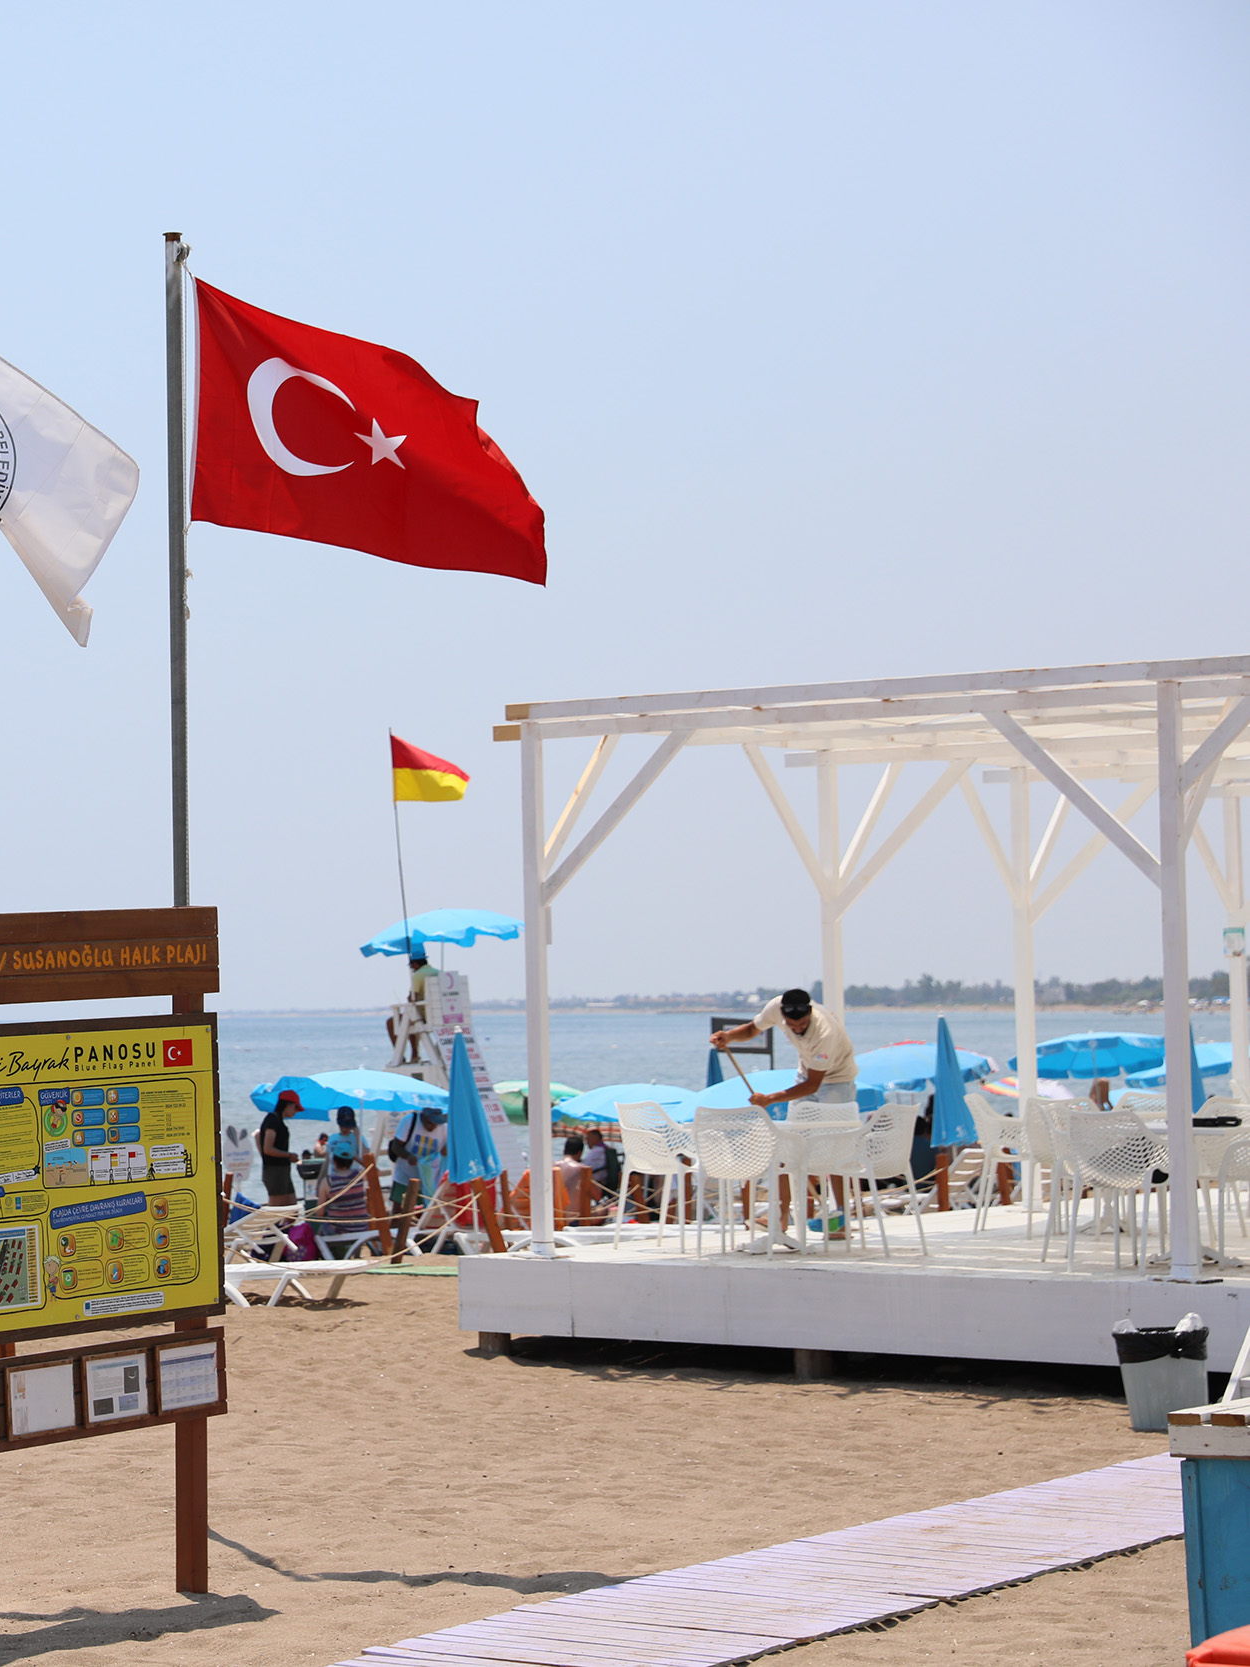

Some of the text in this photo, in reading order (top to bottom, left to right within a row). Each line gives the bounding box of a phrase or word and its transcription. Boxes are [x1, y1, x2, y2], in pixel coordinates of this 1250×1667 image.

[12, 944, 114, 970] SUSANOĞLU
[120, 945, 161, 966] HALK
[166, 943, 207, 965] PLAJI
[6, 1046, 71, 1081] Bayrak
[74, 1042, 156, 1063] PANOSU
[74, 1059, 157, 1072] Blue Flag Panel
